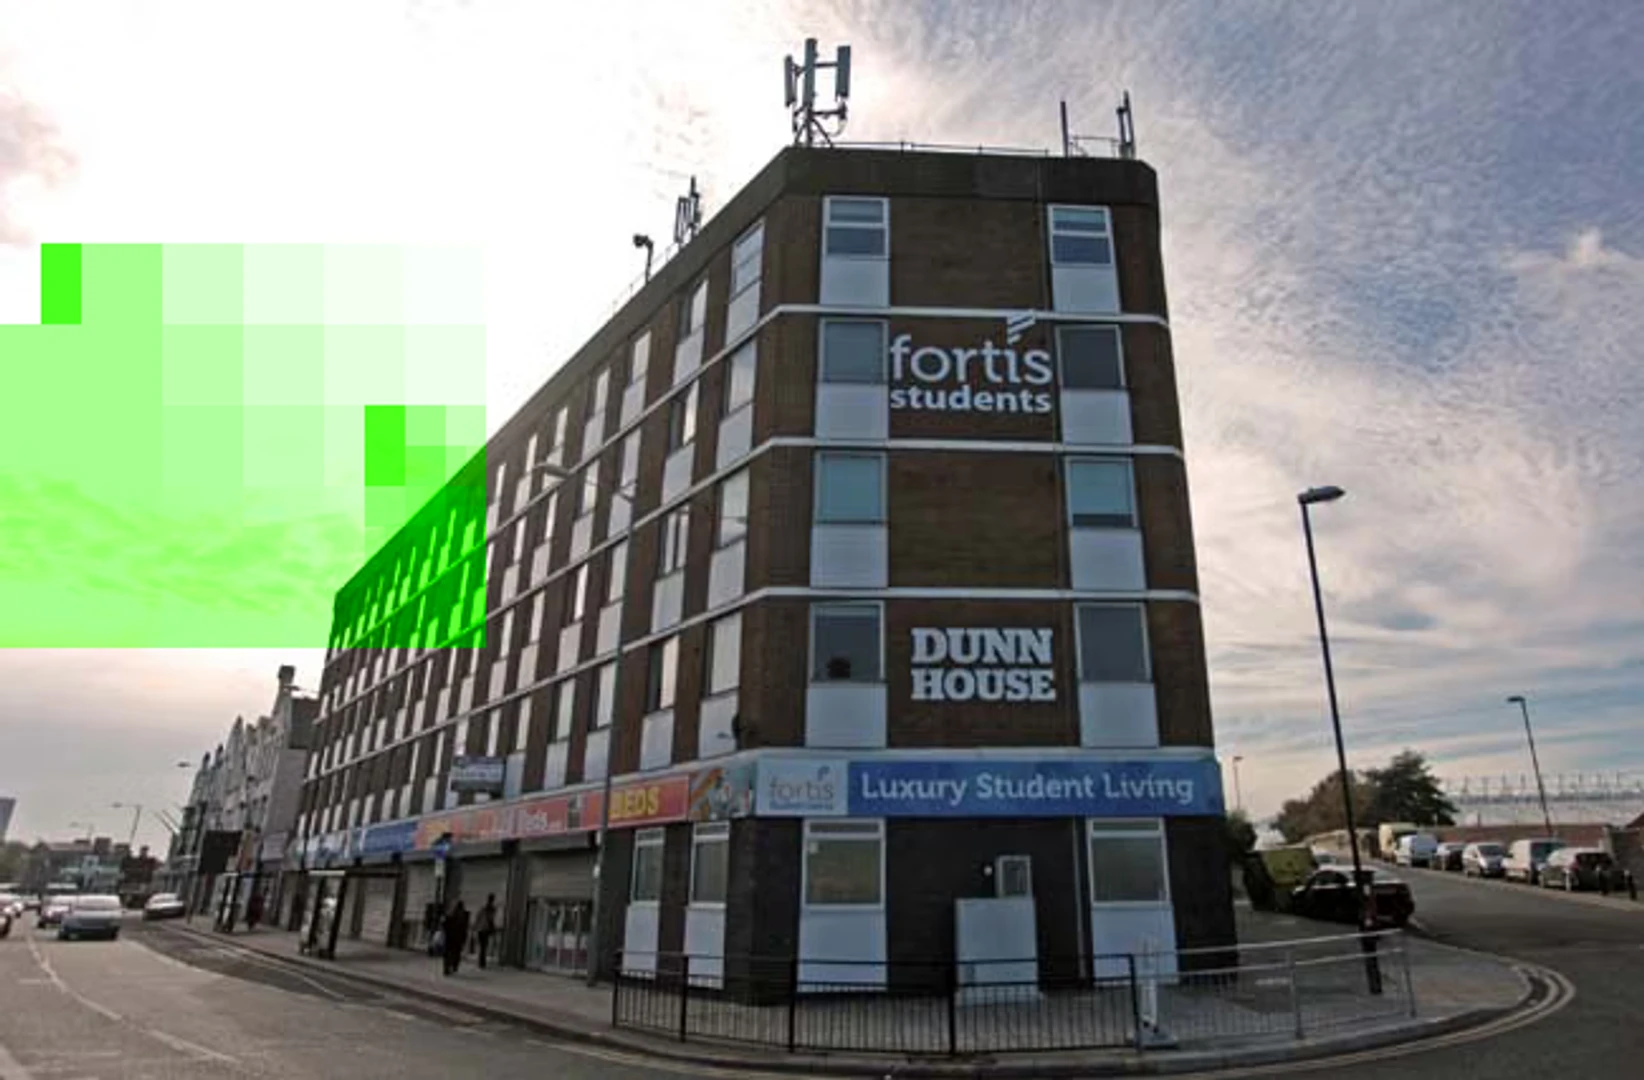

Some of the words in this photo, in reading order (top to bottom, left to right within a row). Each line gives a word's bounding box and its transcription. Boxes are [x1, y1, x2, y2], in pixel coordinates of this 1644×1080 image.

[890, 333, 1052, 384] fortis
[890, 384, 1052, 413] students
[911, 627, 1053, 664] DUNN
[911, 668, 1056, 700] HOUSE
[861, 772, 967, 806] Luxury
[976, 772, 1095, 799] Student
[1103, 772, 1194, 805] Living
